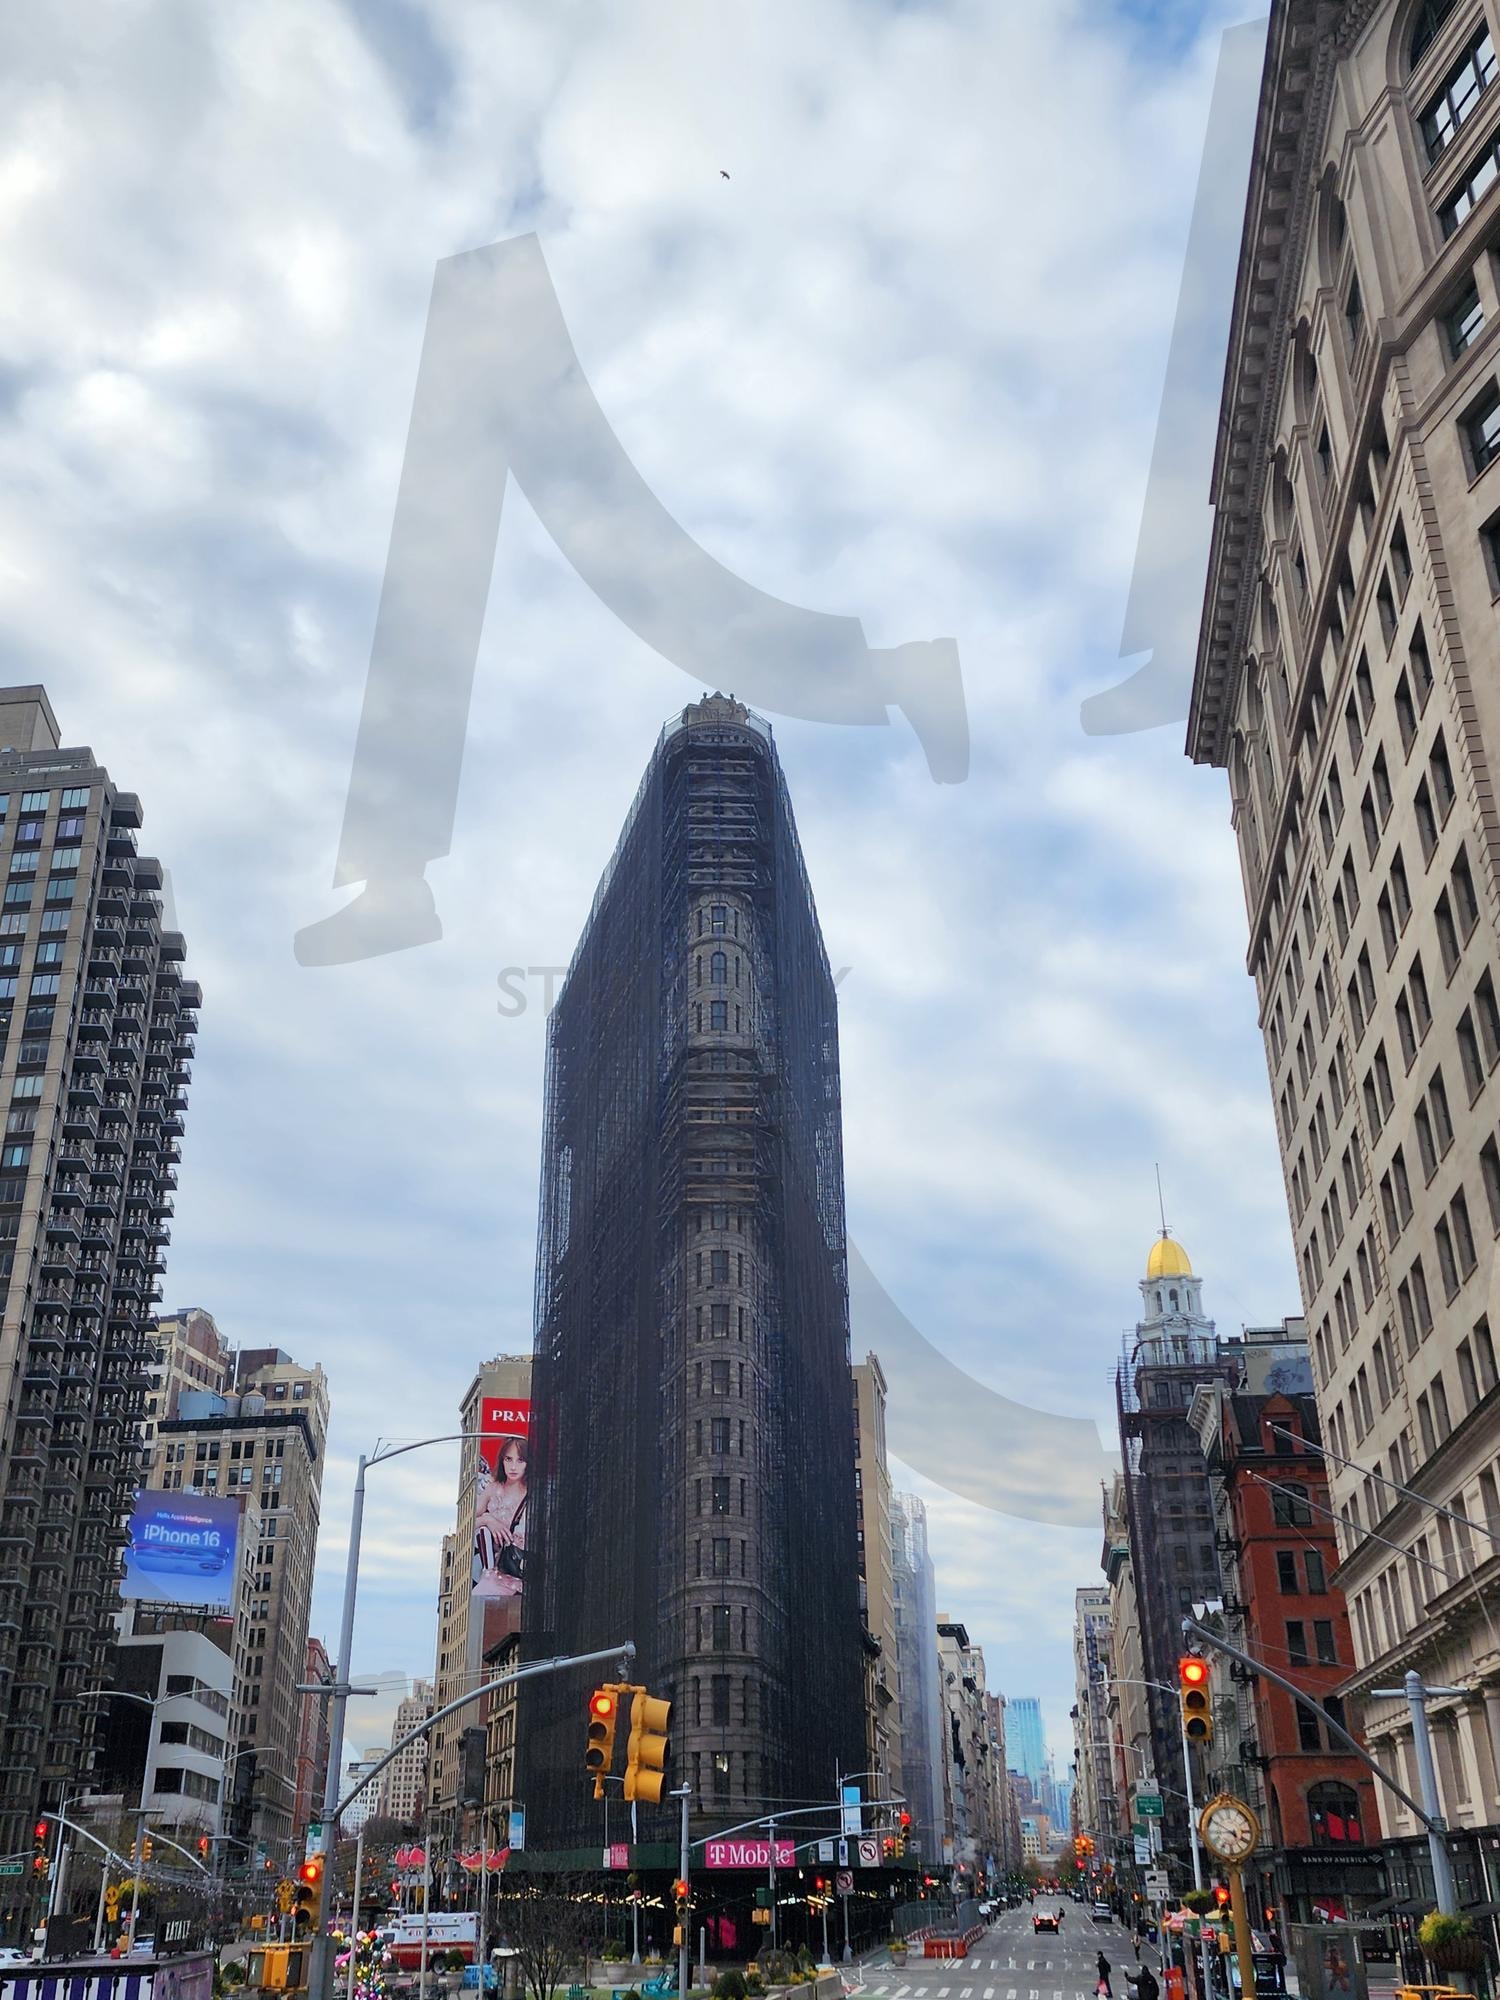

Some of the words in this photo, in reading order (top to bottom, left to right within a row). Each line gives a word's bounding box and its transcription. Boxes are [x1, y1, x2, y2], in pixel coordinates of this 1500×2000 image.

[492, 1409, 532, 1423] PRA
[144, 1524, 200, 1545] iPhone
[203, 1530, 220, 1546] 16
[728, 1844, 790, 1865] Moble
[1302, 1856, 1321, 1864] BANK
[1334, 1856, 1368, 1864] AMERICA
